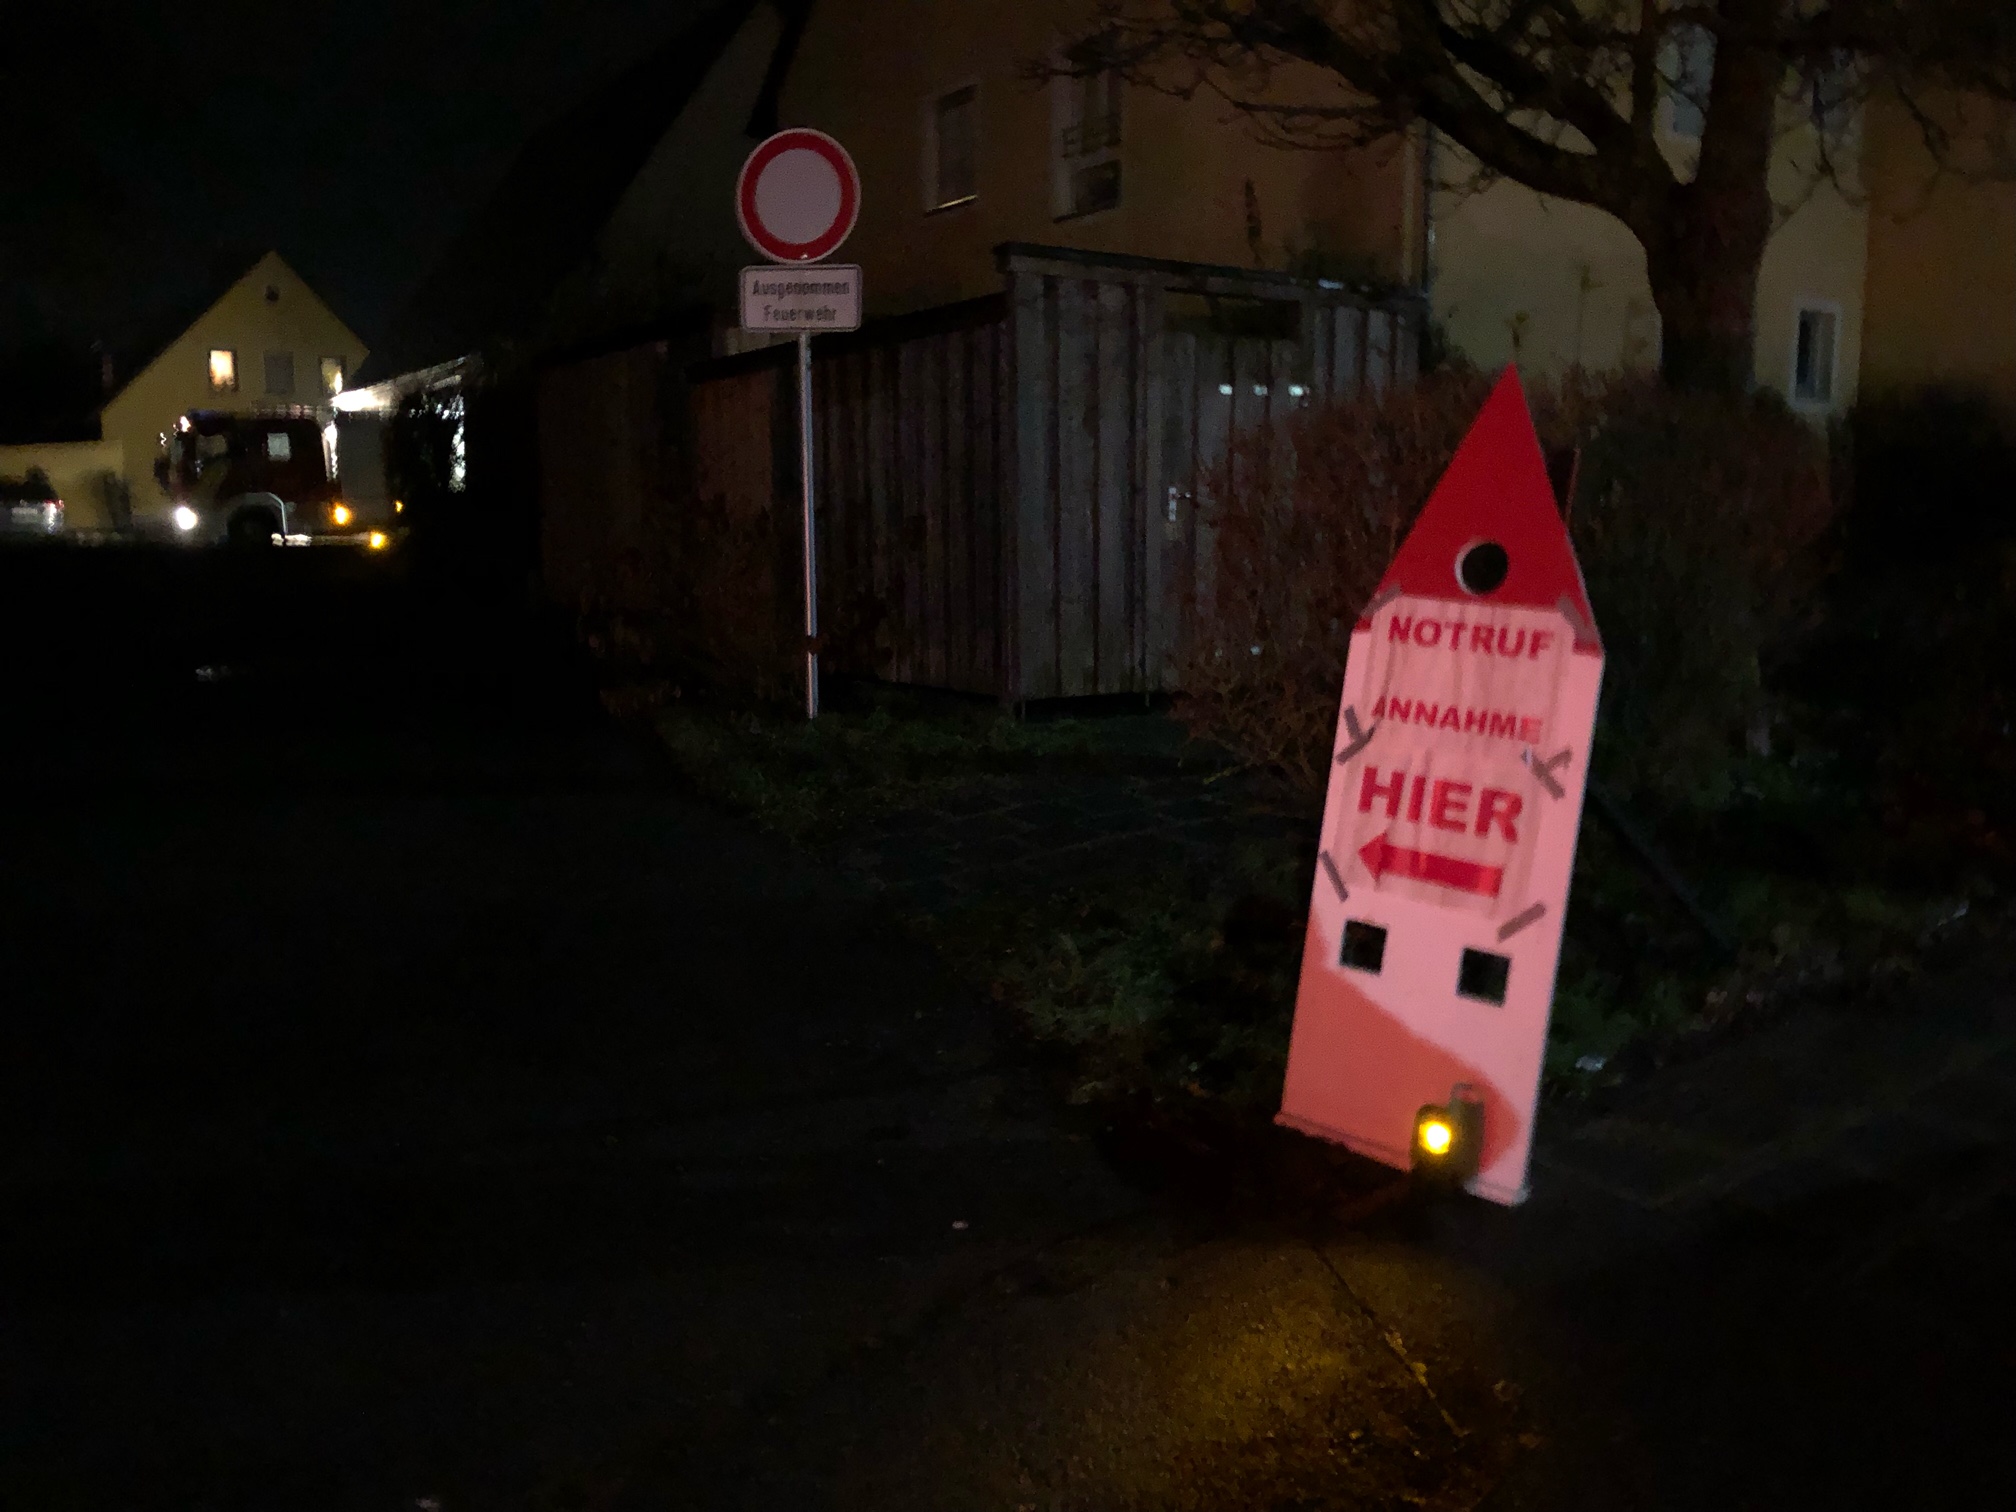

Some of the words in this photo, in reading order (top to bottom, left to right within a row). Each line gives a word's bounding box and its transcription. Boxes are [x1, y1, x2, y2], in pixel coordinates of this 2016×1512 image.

[1387, 615, 1554, 660] NOTRUF
[1371, 695, 1542, 745] ANNAHME
[1358, 766, 1523, 844] HIER
